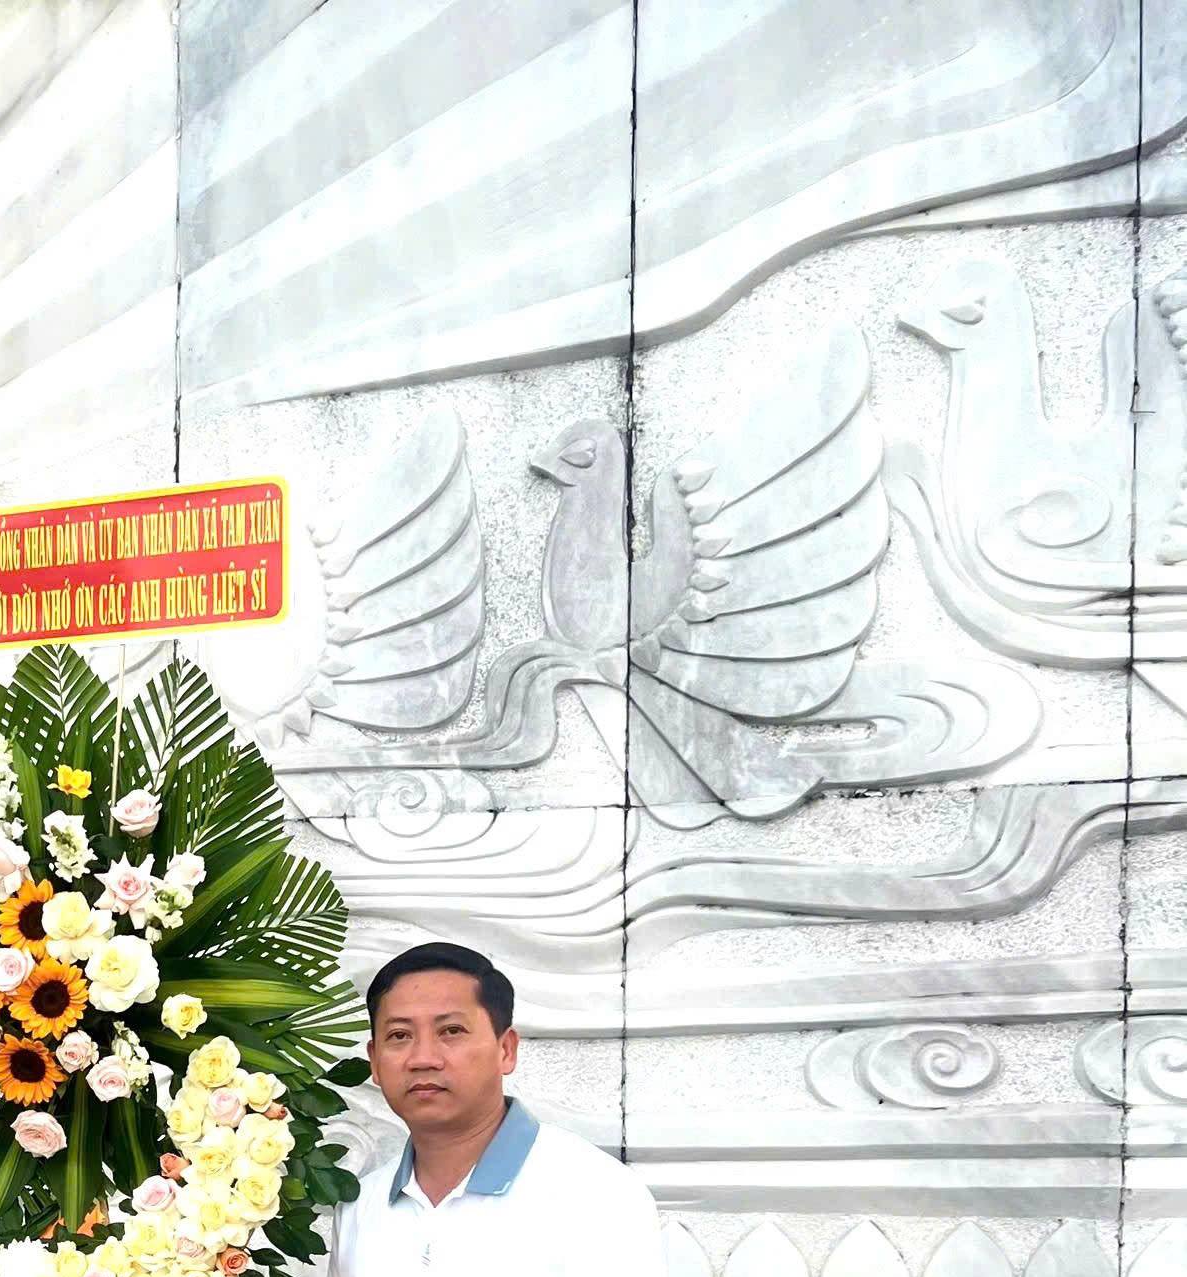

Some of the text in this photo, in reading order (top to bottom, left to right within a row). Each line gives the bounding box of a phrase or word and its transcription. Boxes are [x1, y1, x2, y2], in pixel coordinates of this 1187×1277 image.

[24, 516, 53, 569] NHÂN
[56, 513, 78, 566] DÂN
[82, 511, 96, 563] VÀ
[117, 515, 139, 559] BAN
[142, 503, 173, 556] NHÂN
[177, 500, 199, 552] DÂN
[203, 498, 218, 550] XÃ
[221, 503, 246, 547] TAM
[249, 490, 280, 544] XUÂN
[12, 583, 37, 634] ĐỜI
[41, 578, 71, 631] NHỚ
[75, 581, 94, 628] ƠN
[99, 574, 125, 625] CÁC
[130, 579, 160, 623] ANH
[166, 566, 207, 620] HÙNG
[213, 561, 246, 621] LIỆT
[251, 559, 266, 611] SĨ
